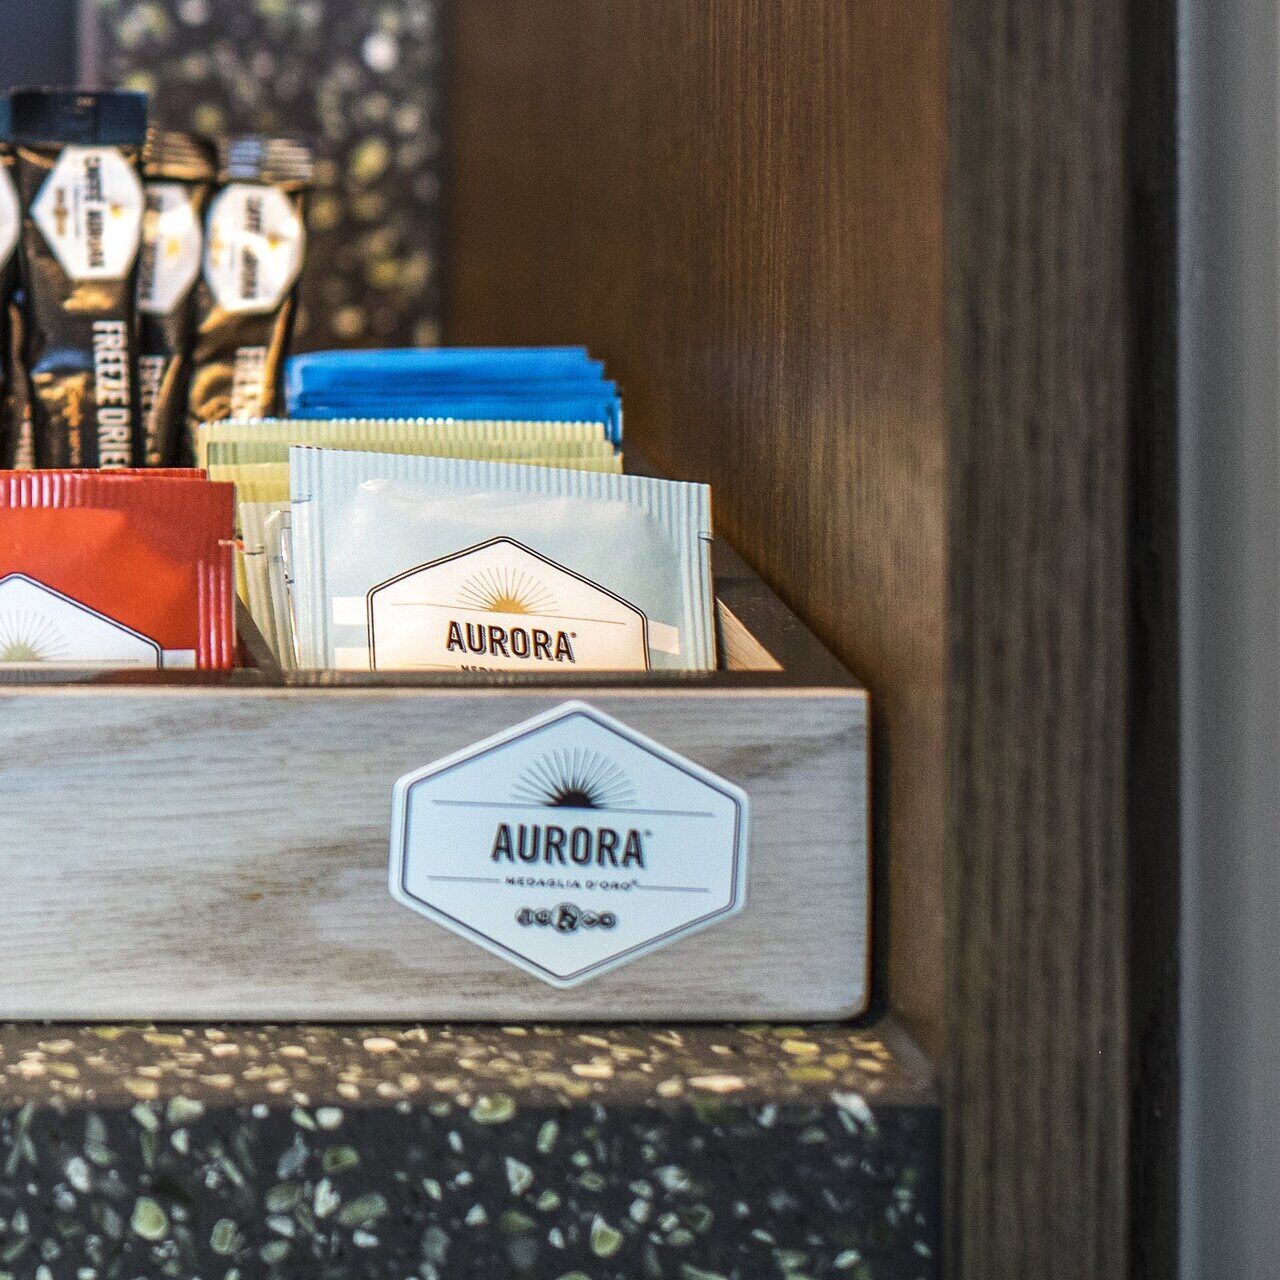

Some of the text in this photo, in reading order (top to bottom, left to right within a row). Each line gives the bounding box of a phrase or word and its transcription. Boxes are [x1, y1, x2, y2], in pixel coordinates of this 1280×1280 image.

[92, 320, 133, 470] FREEZE DRIE
[504, 875, 581, 889] MEDAGLIA
